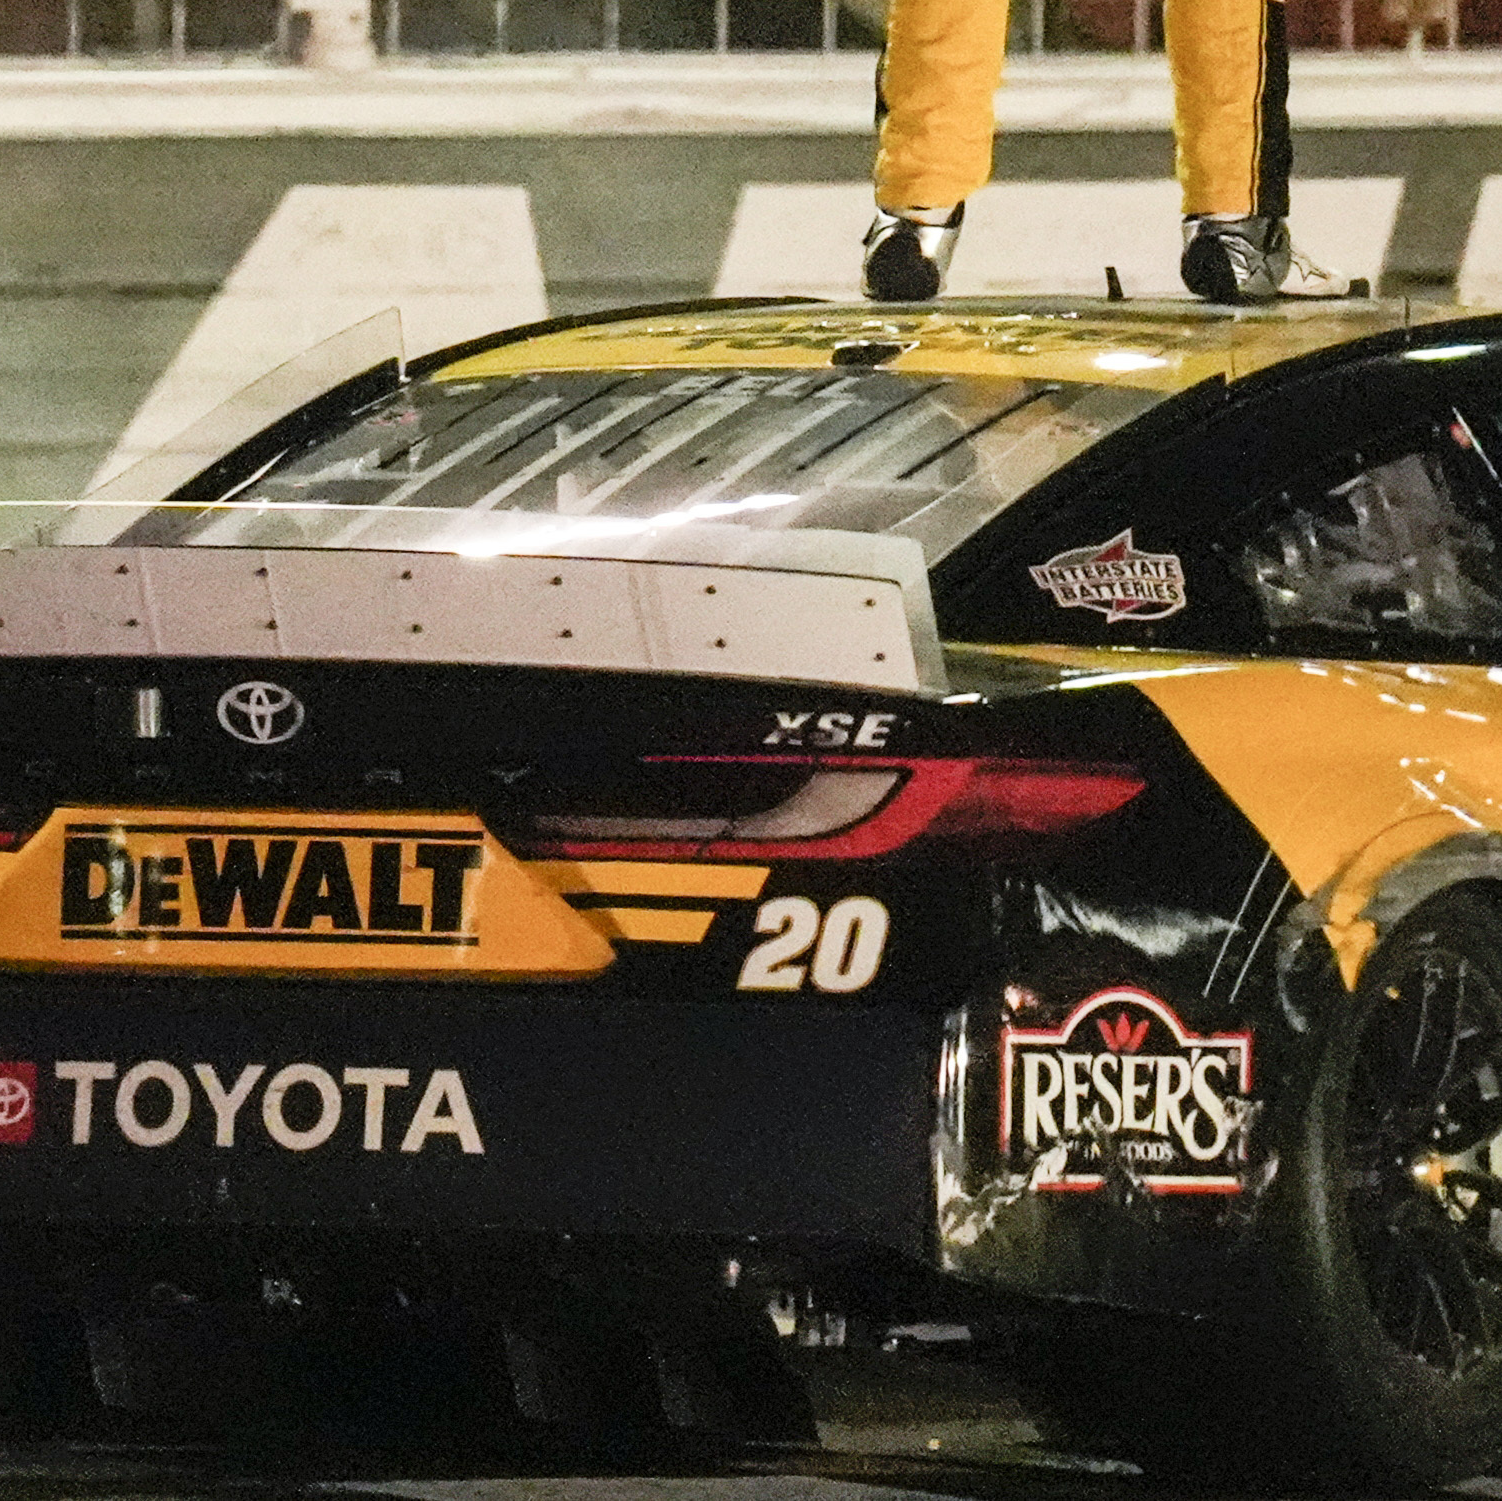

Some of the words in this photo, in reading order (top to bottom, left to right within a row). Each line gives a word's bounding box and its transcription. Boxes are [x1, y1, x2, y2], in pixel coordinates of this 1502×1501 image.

[1036, 560, 1178, 585] INTERSTATE
[1058, 583, 1181, 602] BATTERIES
[761, 710, 896, 749] XSE
[735, 896, 891, 995] 20
[54, 1058, 486, 1155] TOYOTA
